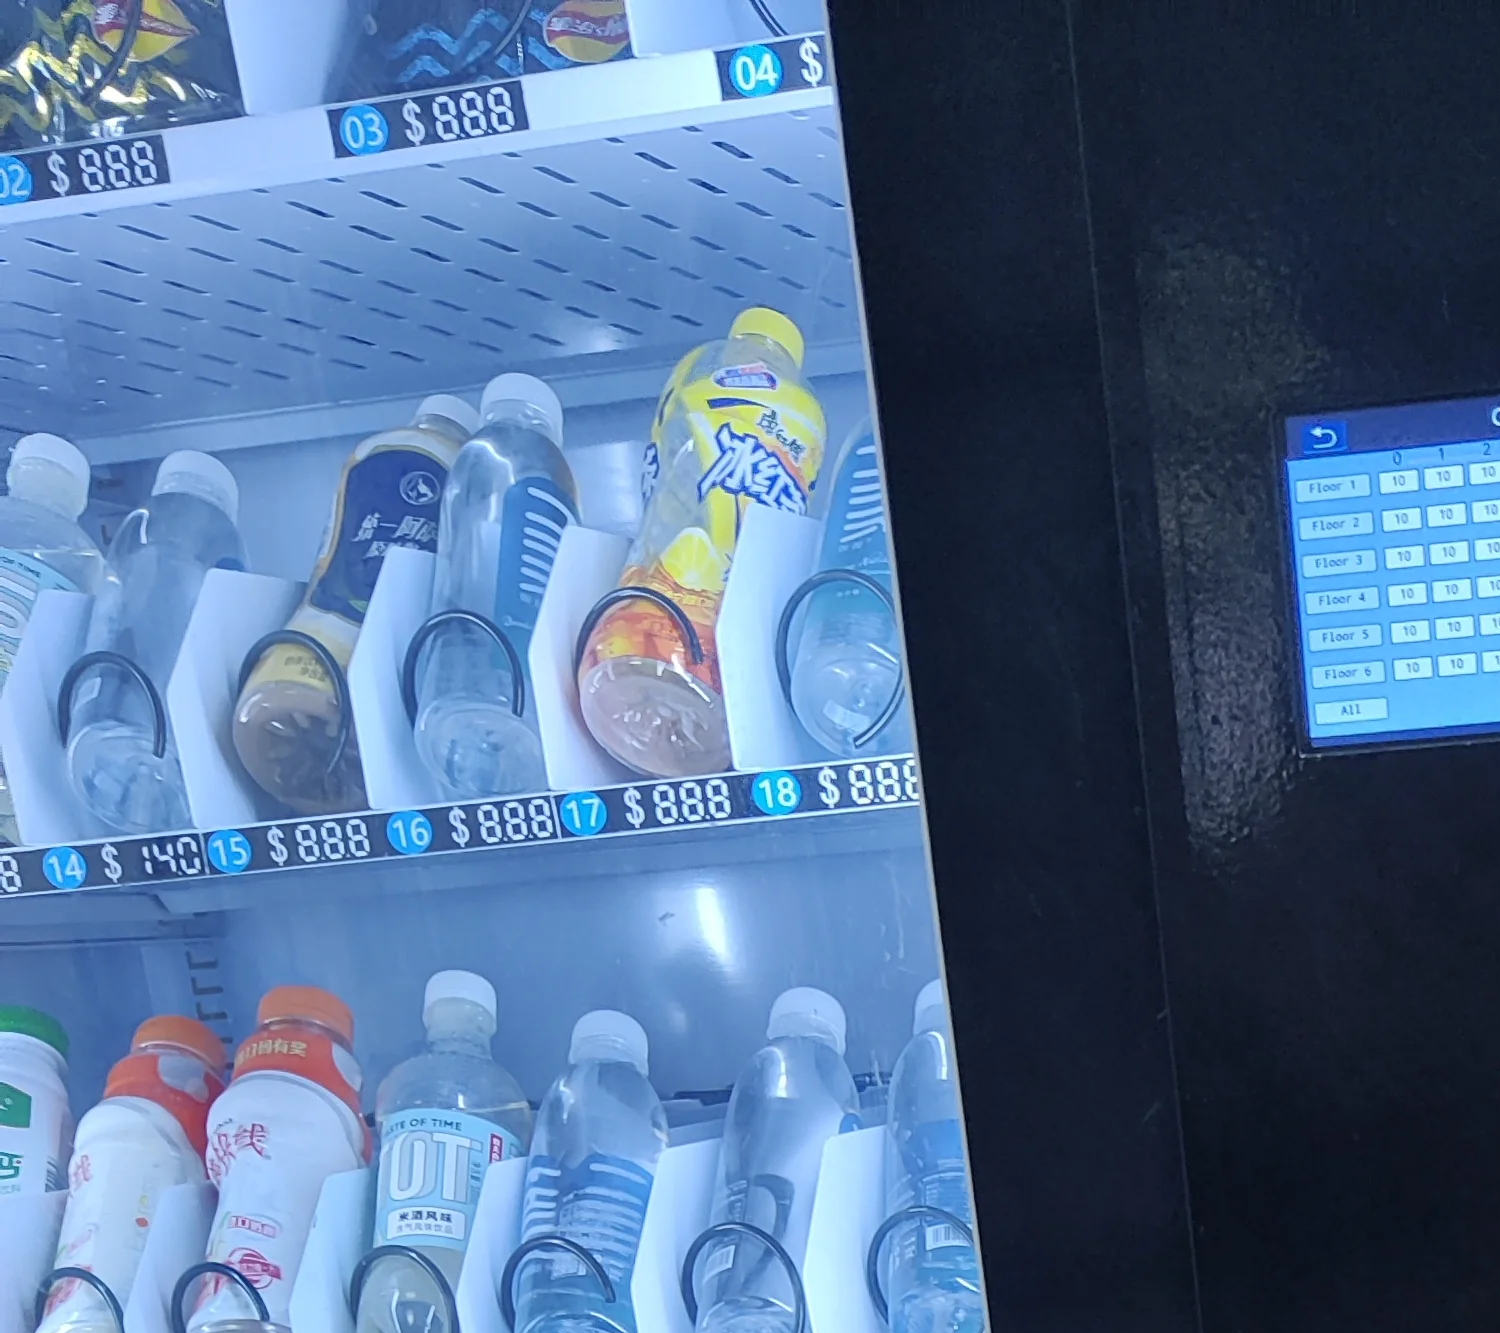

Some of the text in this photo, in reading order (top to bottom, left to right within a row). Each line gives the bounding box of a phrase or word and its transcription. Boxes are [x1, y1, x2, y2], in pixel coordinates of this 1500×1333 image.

[736, 53, 779, 90] 04
[344, 115, 385, 148] 03
[1393, 452, 1401, 465] 0
[1483, 443, 1490, 455] 2
[1308, 480, 1343, 494] Floor
[1311, 519, 1346, 532] Floor
[1315, 557, 1349, 568] Floor
[1318, 593, 1352, 605] Floor
[1322, 630, 1355, 643] Floor
[1325, 667, 1359, 680] Floor
[759, 777, 796, 808] 18
[566, 799, 600, 829] 17
[393, 818, 428, 847] 16
[212, 837, 248, 866] 15
[49, 853, 83, 882] 14
